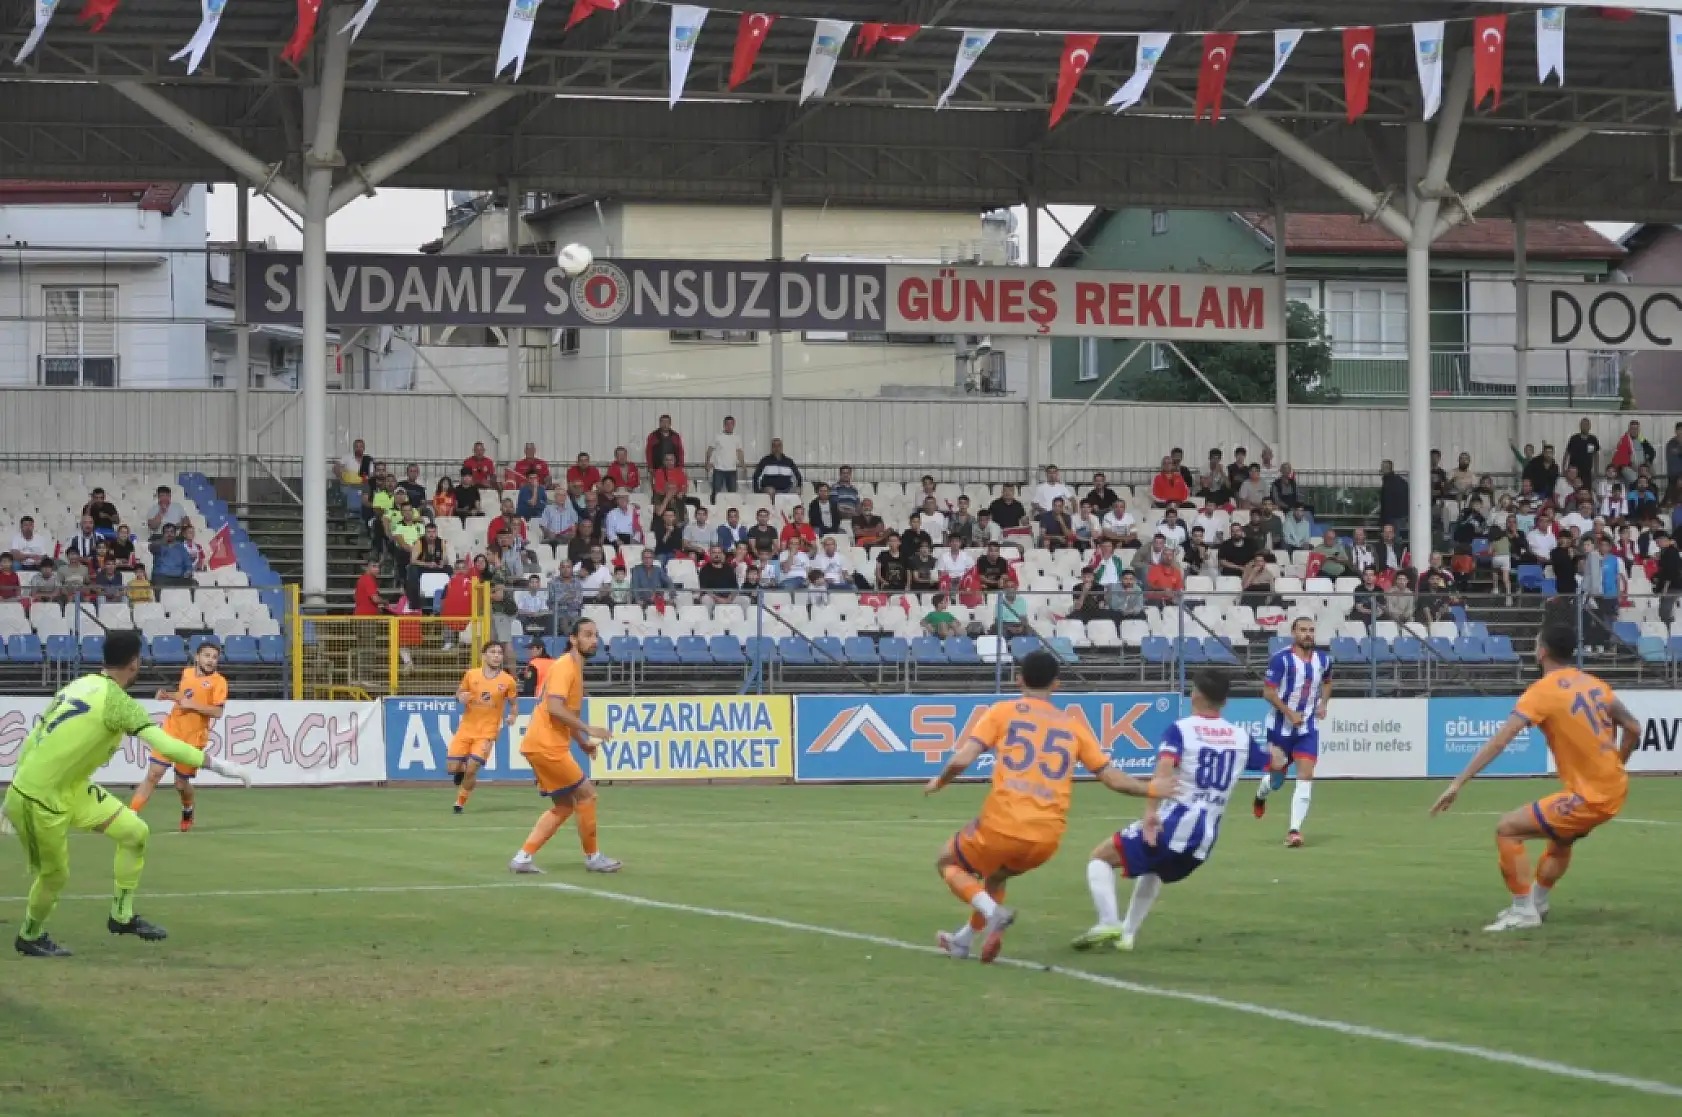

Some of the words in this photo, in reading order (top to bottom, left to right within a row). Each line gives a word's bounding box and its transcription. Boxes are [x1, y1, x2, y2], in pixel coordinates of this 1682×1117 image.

[897, 268, 1058, 334] GÜNEŞ
[1076, 281, 1265, 330] REKLAM
[399, 700, 457, 711] FETHİYE
[606, 701, 773, 734] PAZARLAMA
[1332, 717, 1369, 733] İkinci
[1372, 719, 1402, 733] elde
[602, 739, 661, 771] YAPI
[669, 738, 781, 770] MARKET
[1003, 720, 1074, 781] 55
[1321, 739, 1349, 754] yeni
[1353, 739, 1371, 752] bir
[1375, 738, 1413, 752] nefes
[1195, 747, 1237, 791] 80
